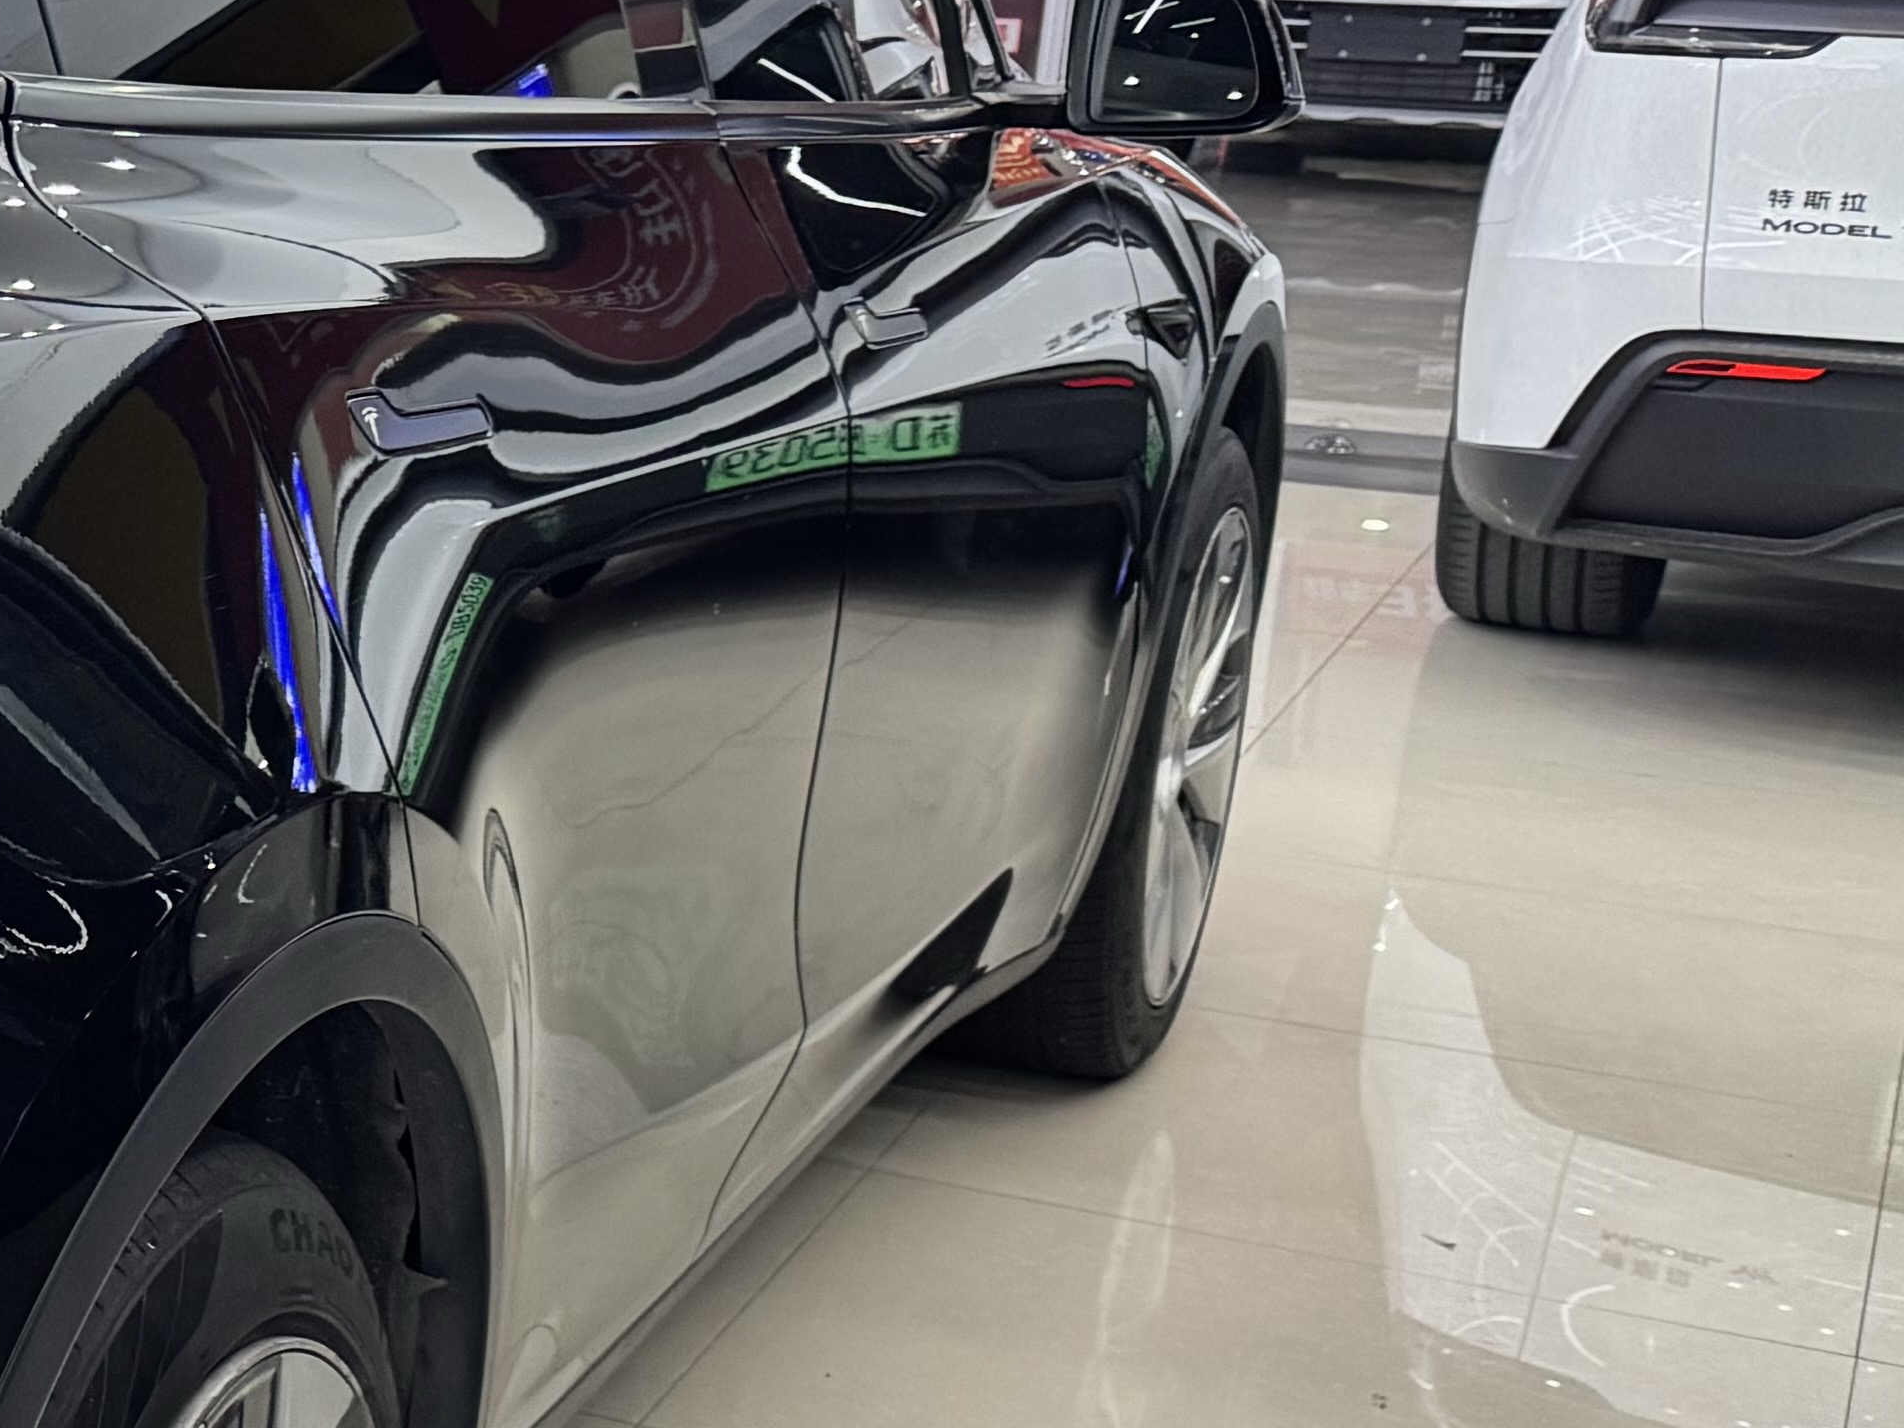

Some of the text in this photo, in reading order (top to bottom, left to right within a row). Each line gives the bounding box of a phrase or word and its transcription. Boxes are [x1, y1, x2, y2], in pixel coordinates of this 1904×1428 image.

[1767, 188, 1869, 213] 特斯拉
[1761, 218, 1893, 239] MODEL
